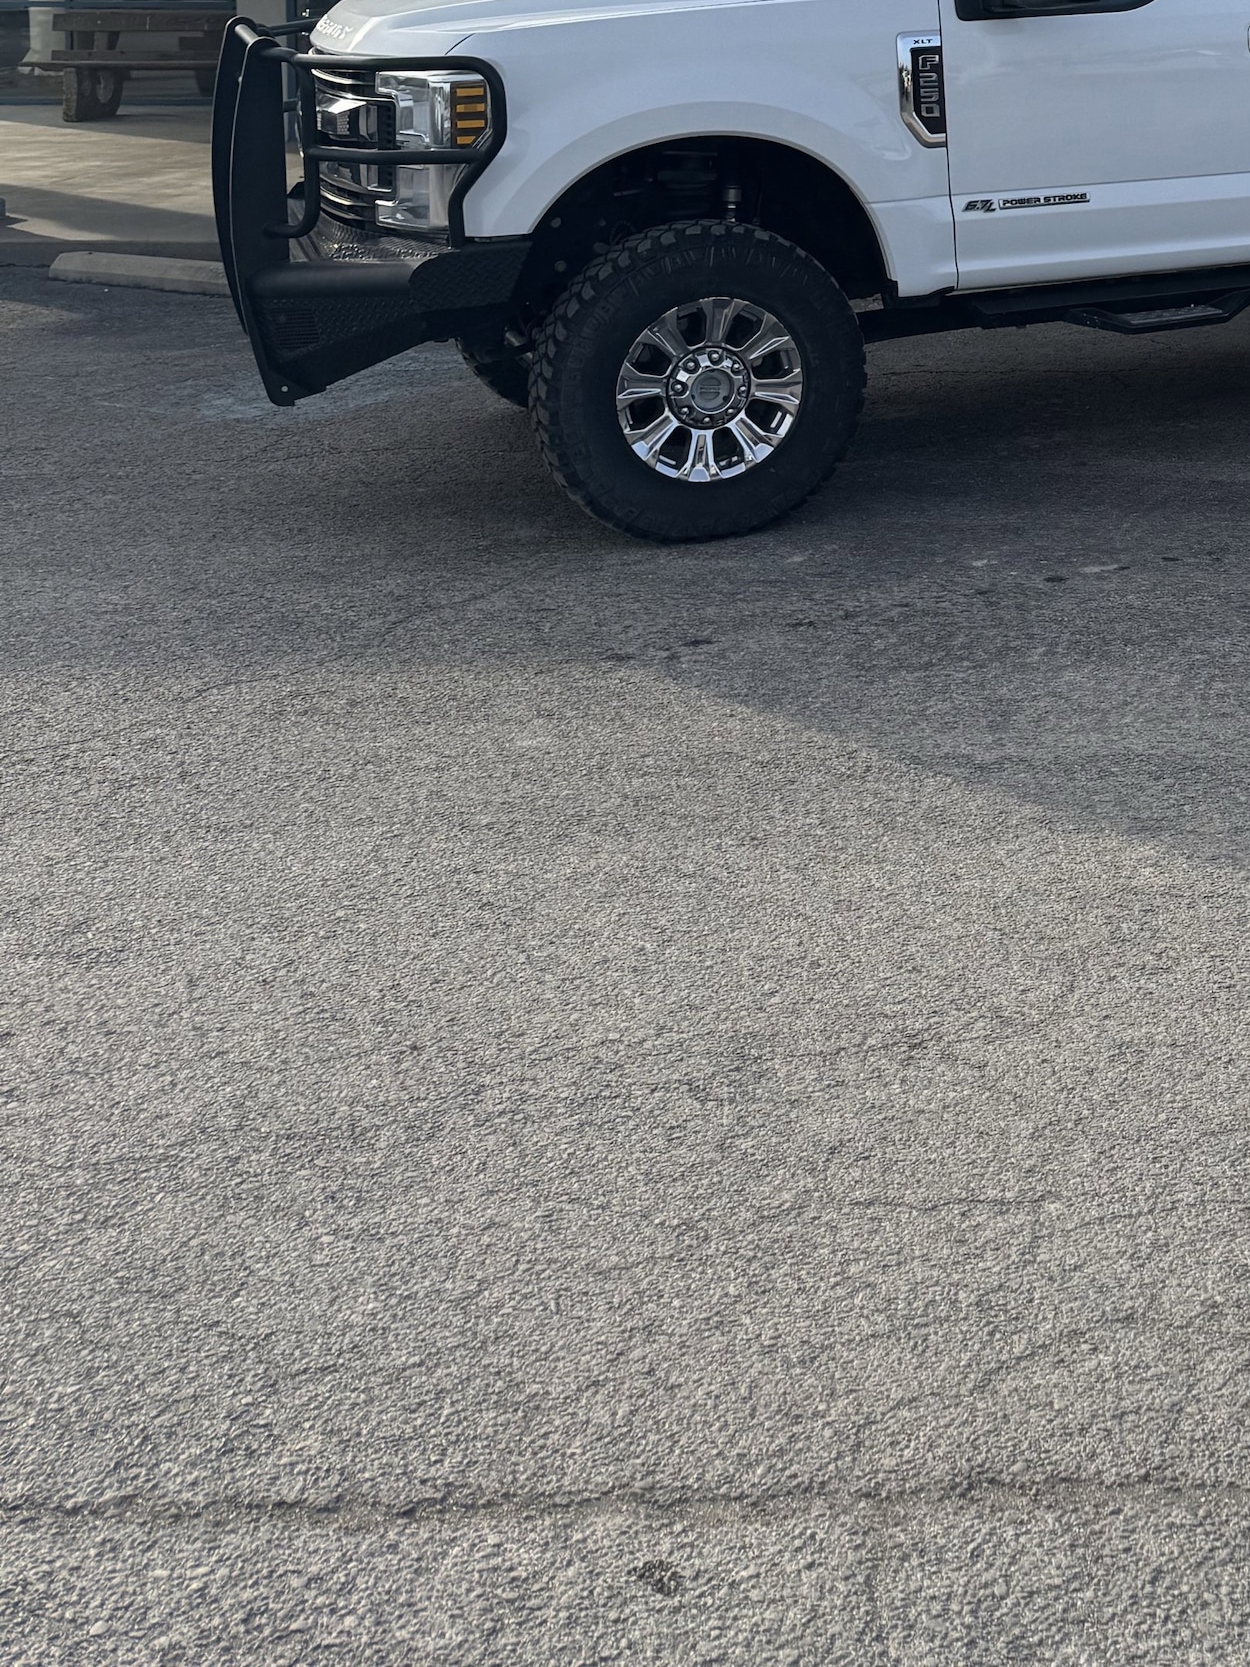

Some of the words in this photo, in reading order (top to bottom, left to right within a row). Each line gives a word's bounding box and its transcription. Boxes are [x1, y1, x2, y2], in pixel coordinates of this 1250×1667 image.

[919, 55, 940, 117] F250
[962, 199, 997, 213] 6.7L
[1002, 196, 1042, 207] POWER
[1043, 192, 1088, 203] STROKE
